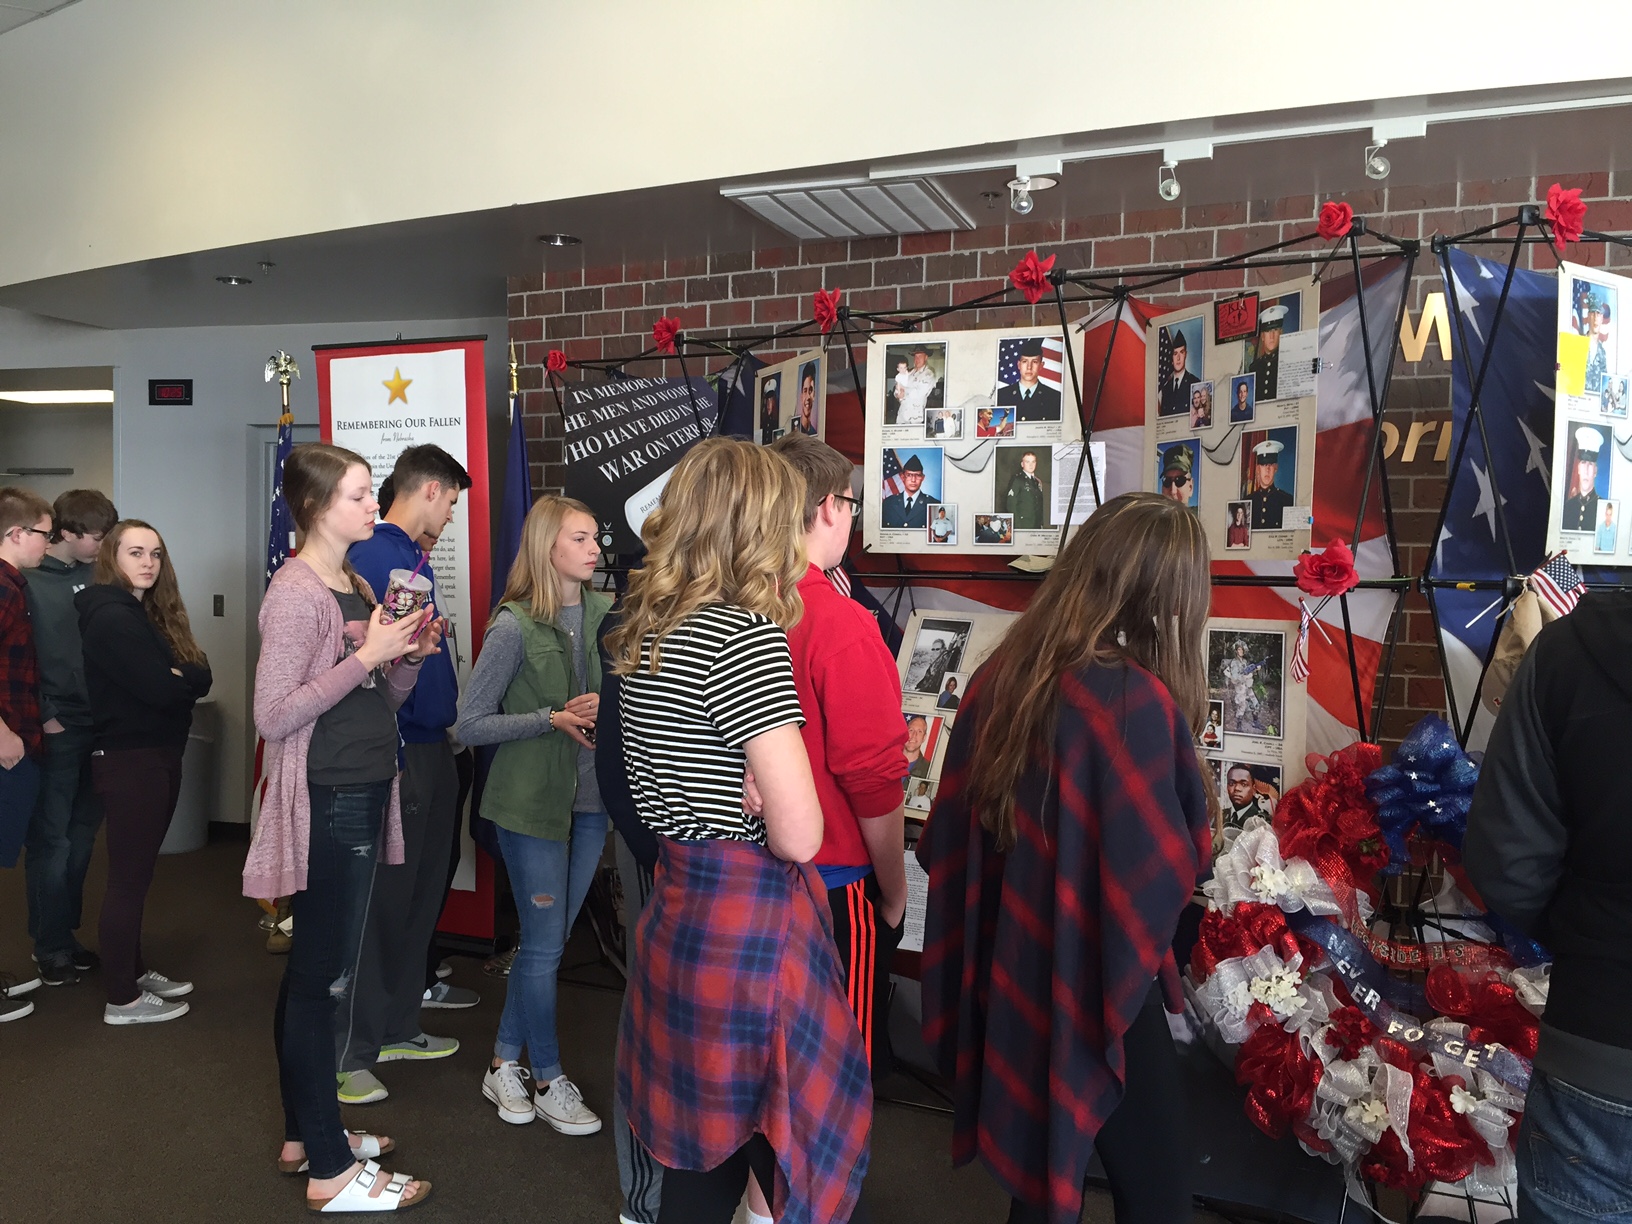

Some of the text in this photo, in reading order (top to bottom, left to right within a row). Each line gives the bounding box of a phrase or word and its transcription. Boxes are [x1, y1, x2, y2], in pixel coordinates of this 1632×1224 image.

[572, 389, 594, 404] IN
[594, 378, 654, 399] MEMORY
[336, 416, 461, 430] REMEMBERING OUR FALLEN
[564, 412, 592, 432] HE
[590, 402, 630, 422] MEN
[630, 394, 658, 412] AND
[564, 436, 602, 466] HO
[602, 418, 651, 448] HAVE
[648, 408, 680, 428] DIED
[678, 402, 694, 416] IN
[598, 449, 648, 482] WAR
[646, 438, 672, 460] ON
